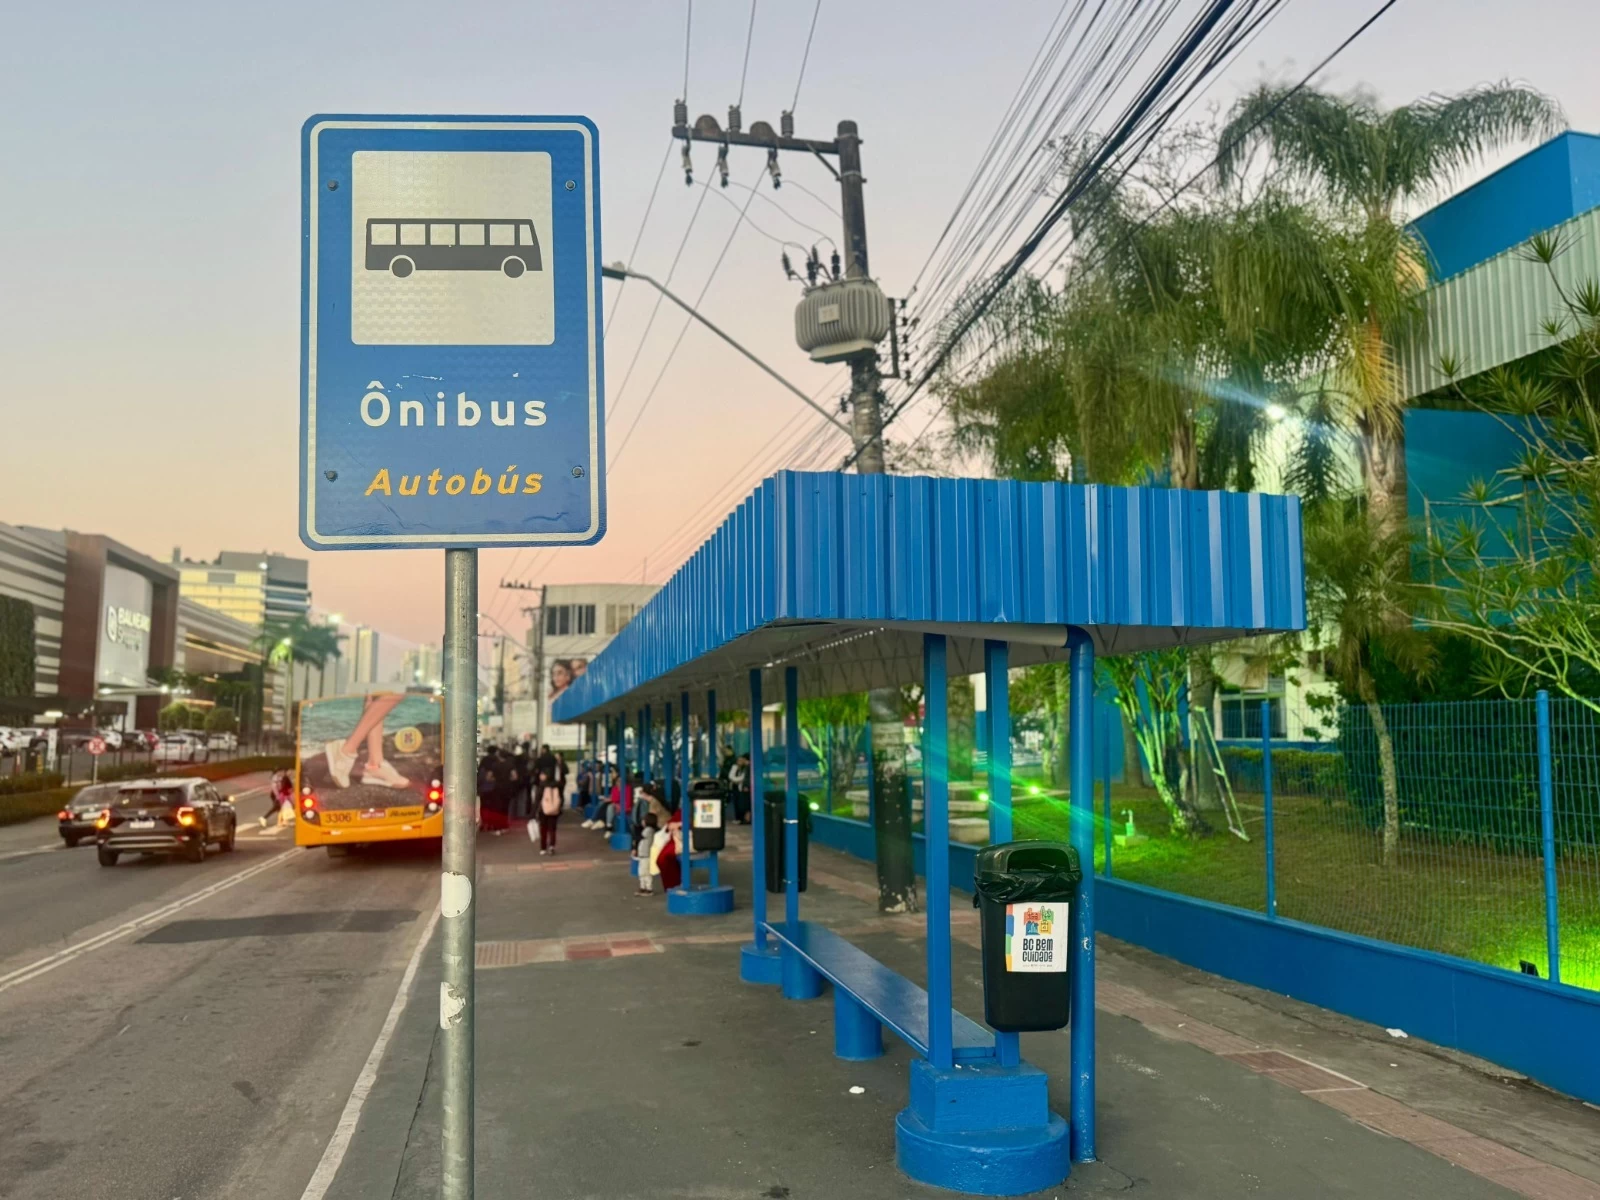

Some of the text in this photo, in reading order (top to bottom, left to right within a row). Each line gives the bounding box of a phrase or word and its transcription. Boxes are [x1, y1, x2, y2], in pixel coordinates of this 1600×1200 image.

[360, 380, 547, 427] Ônibus
[364, 464, 543, 496] Autobús
[325, 812, 352, 824] 3306
[1023, 938, 1034, 950] BC
